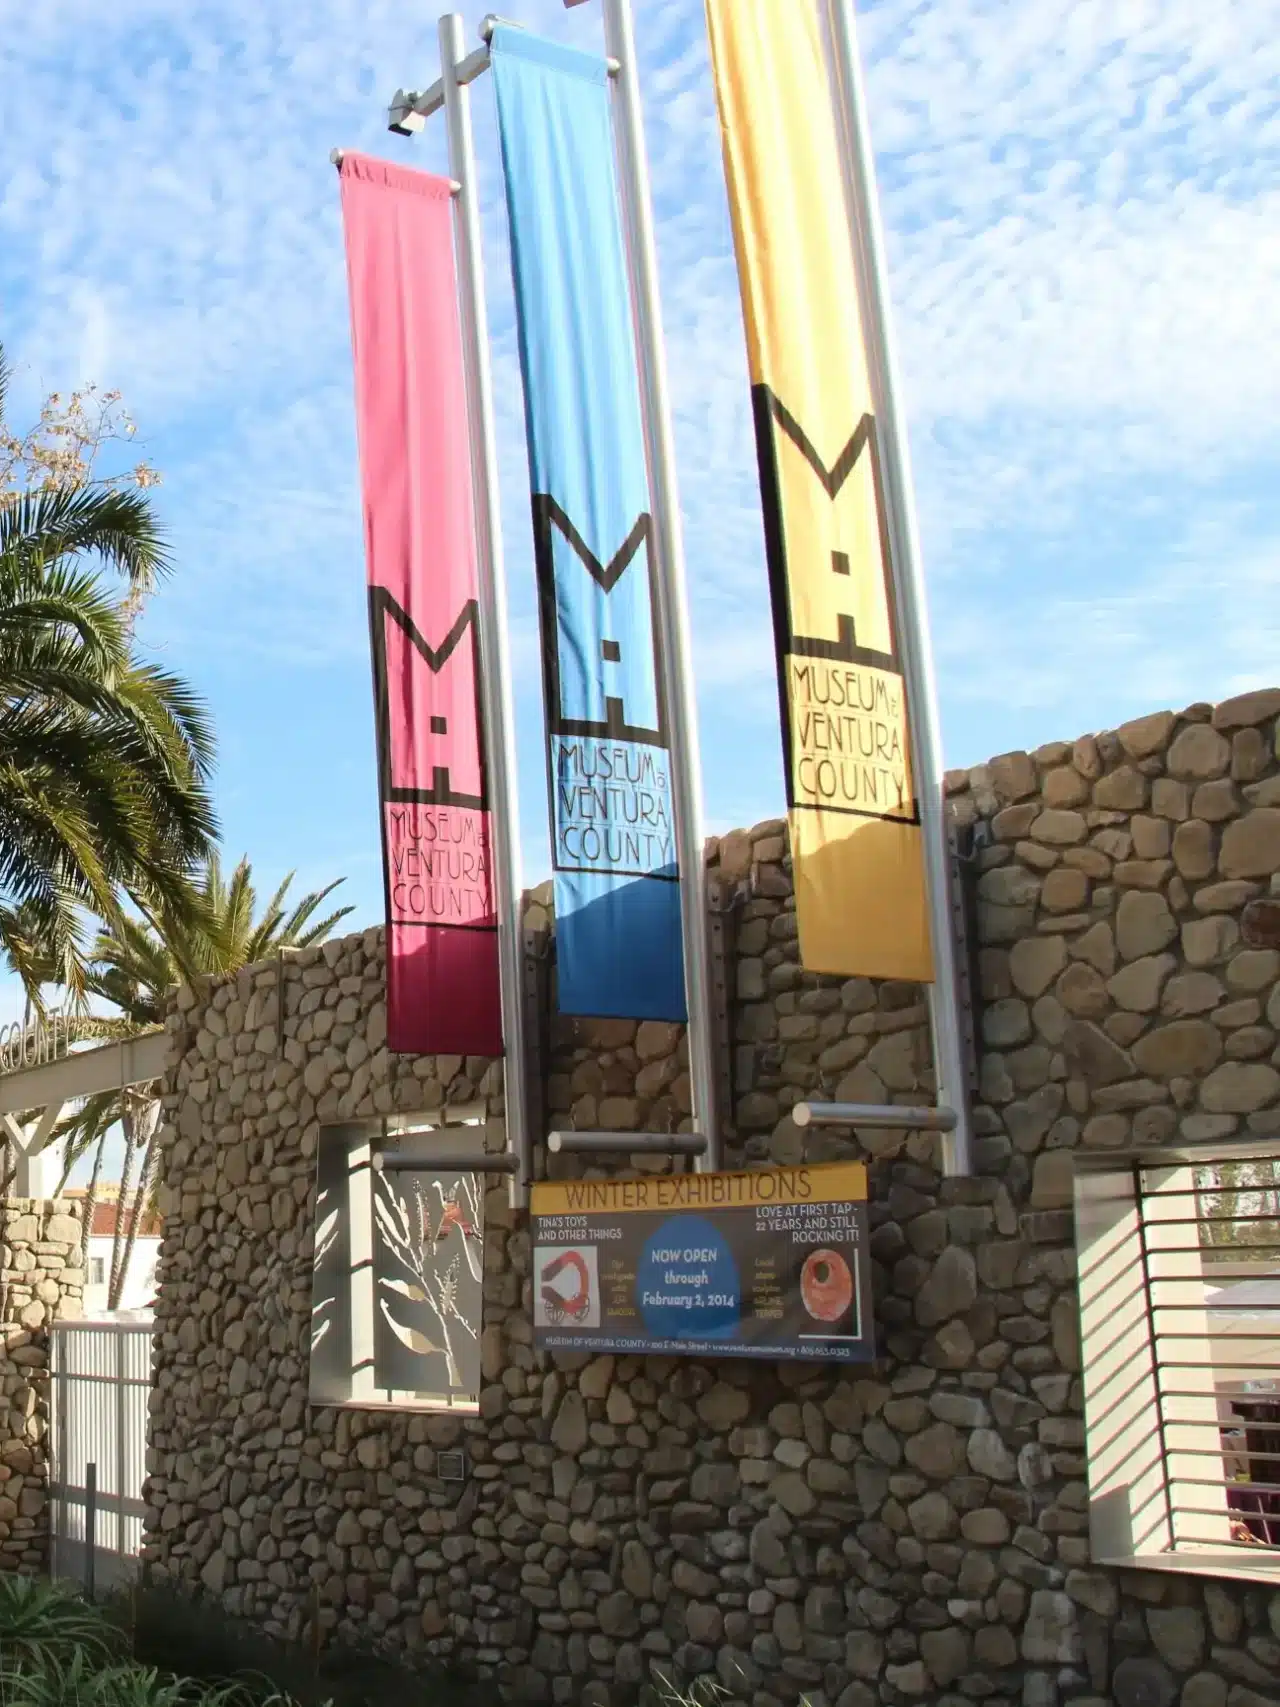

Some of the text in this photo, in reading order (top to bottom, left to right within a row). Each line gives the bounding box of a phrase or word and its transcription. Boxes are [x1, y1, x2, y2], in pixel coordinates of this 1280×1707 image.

[793, 664, 890, 716] MUSEUM
[798, 711, 902, 763] VENTURA
[558, 743, 656, 786] MUSEUM
[799, 757, 904, 809] COUNTY
[560, 784, 668, 828] VENTURA
[391, 810, 476, 847] MUSEUM
[392, 847, 487, 882] VENTURA
[563, 826, 668, 868] COUNTY
[393, 883, 488, 919] COUNTY
[564, 1170, 812, 1208] WINTER EXHIBITIONS
[564, 1216, 588, 1227] TOYS
[755, 1216, 859, 1231] 22 YEARS AND STILL
[756, 1206, 784, 1218] LOVE
[785, 1205, 798, 1216] AT
[800, 1204, 827, 1216] FIRST
[538, 1228, 622, 1241] AND OTHER THINGS
[792, 1230, 844, 1243] ROCKING
[651, 1248, 717, 1263] NOW OPEN
[664, 1269, 709, 1288] through
[642, 1291, 693, 1309] February
[707, 1294, 735, 1307] 2014
[616, 1338, 647, 1349] COUNTY
